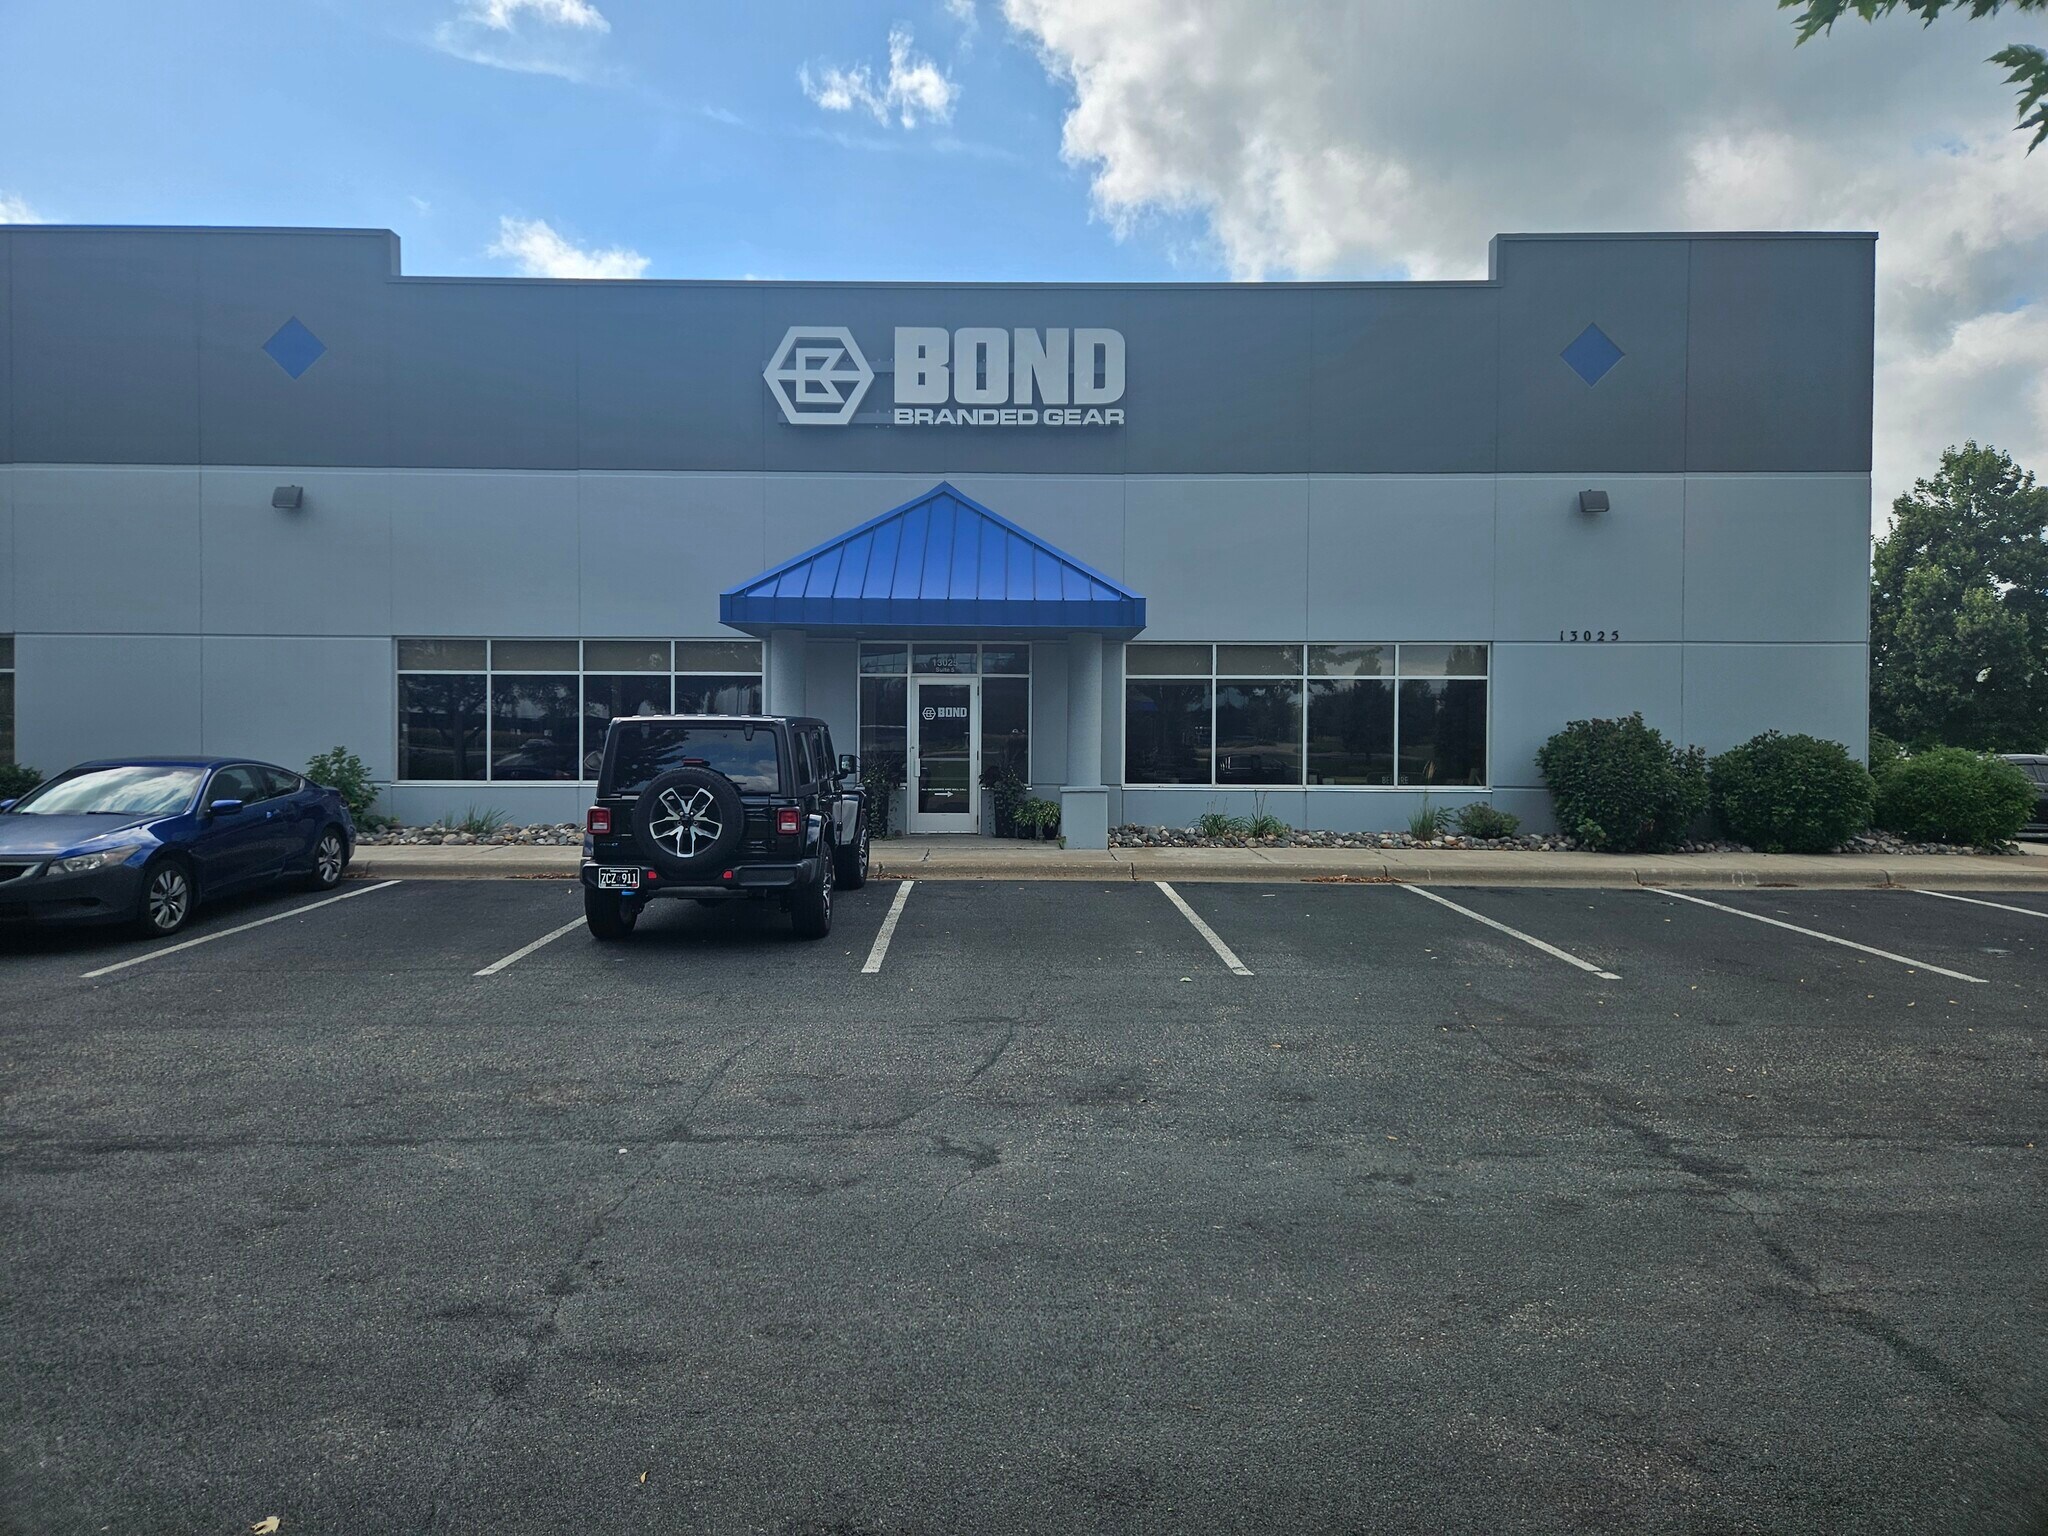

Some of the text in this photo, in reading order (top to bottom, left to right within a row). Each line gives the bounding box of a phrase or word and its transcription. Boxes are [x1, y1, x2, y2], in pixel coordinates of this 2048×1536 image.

[894, 326, 1125, 405] BOND
[894, 408, 1125, 425] BRANDED GEAR
[1560, 630, 1619, 642] 13025
[932, 658, 959, 667] 13025
[937, 707, 968, 718] BOND
[601, 873, 637, 884] ZCZ 911
